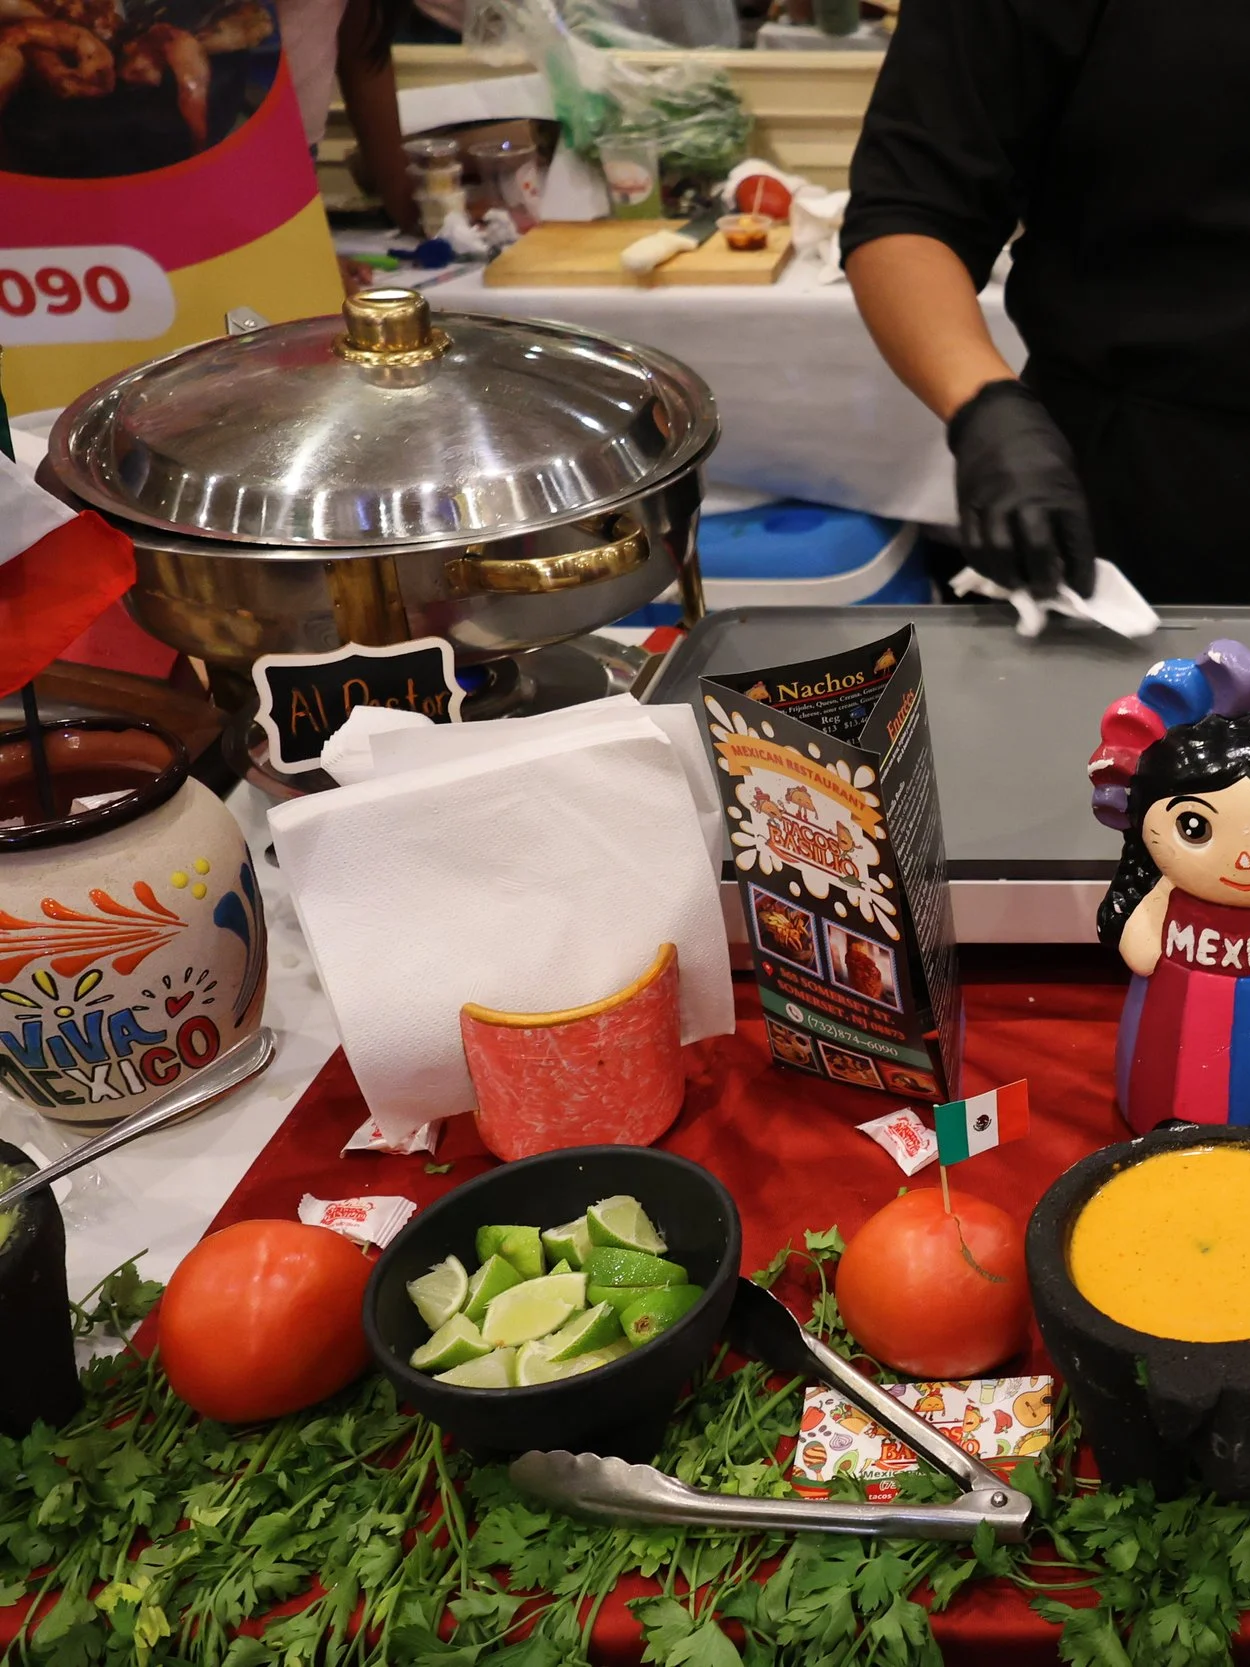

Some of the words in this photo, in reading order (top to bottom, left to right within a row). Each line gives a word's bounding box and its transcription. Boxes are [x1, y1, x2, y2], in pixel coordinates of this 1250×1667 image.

[776, 671, 865, 702] Nachos
[291, 684, 329, 737] Al
[821, 715, 841, 725] Reg
[731, 745, 784, 766] MEXICAN
[785, 758, 867, 812] RESTAURANT
[767, 821, 860, 881] BASILIO
[782, 816, 841, 855] TACOS
